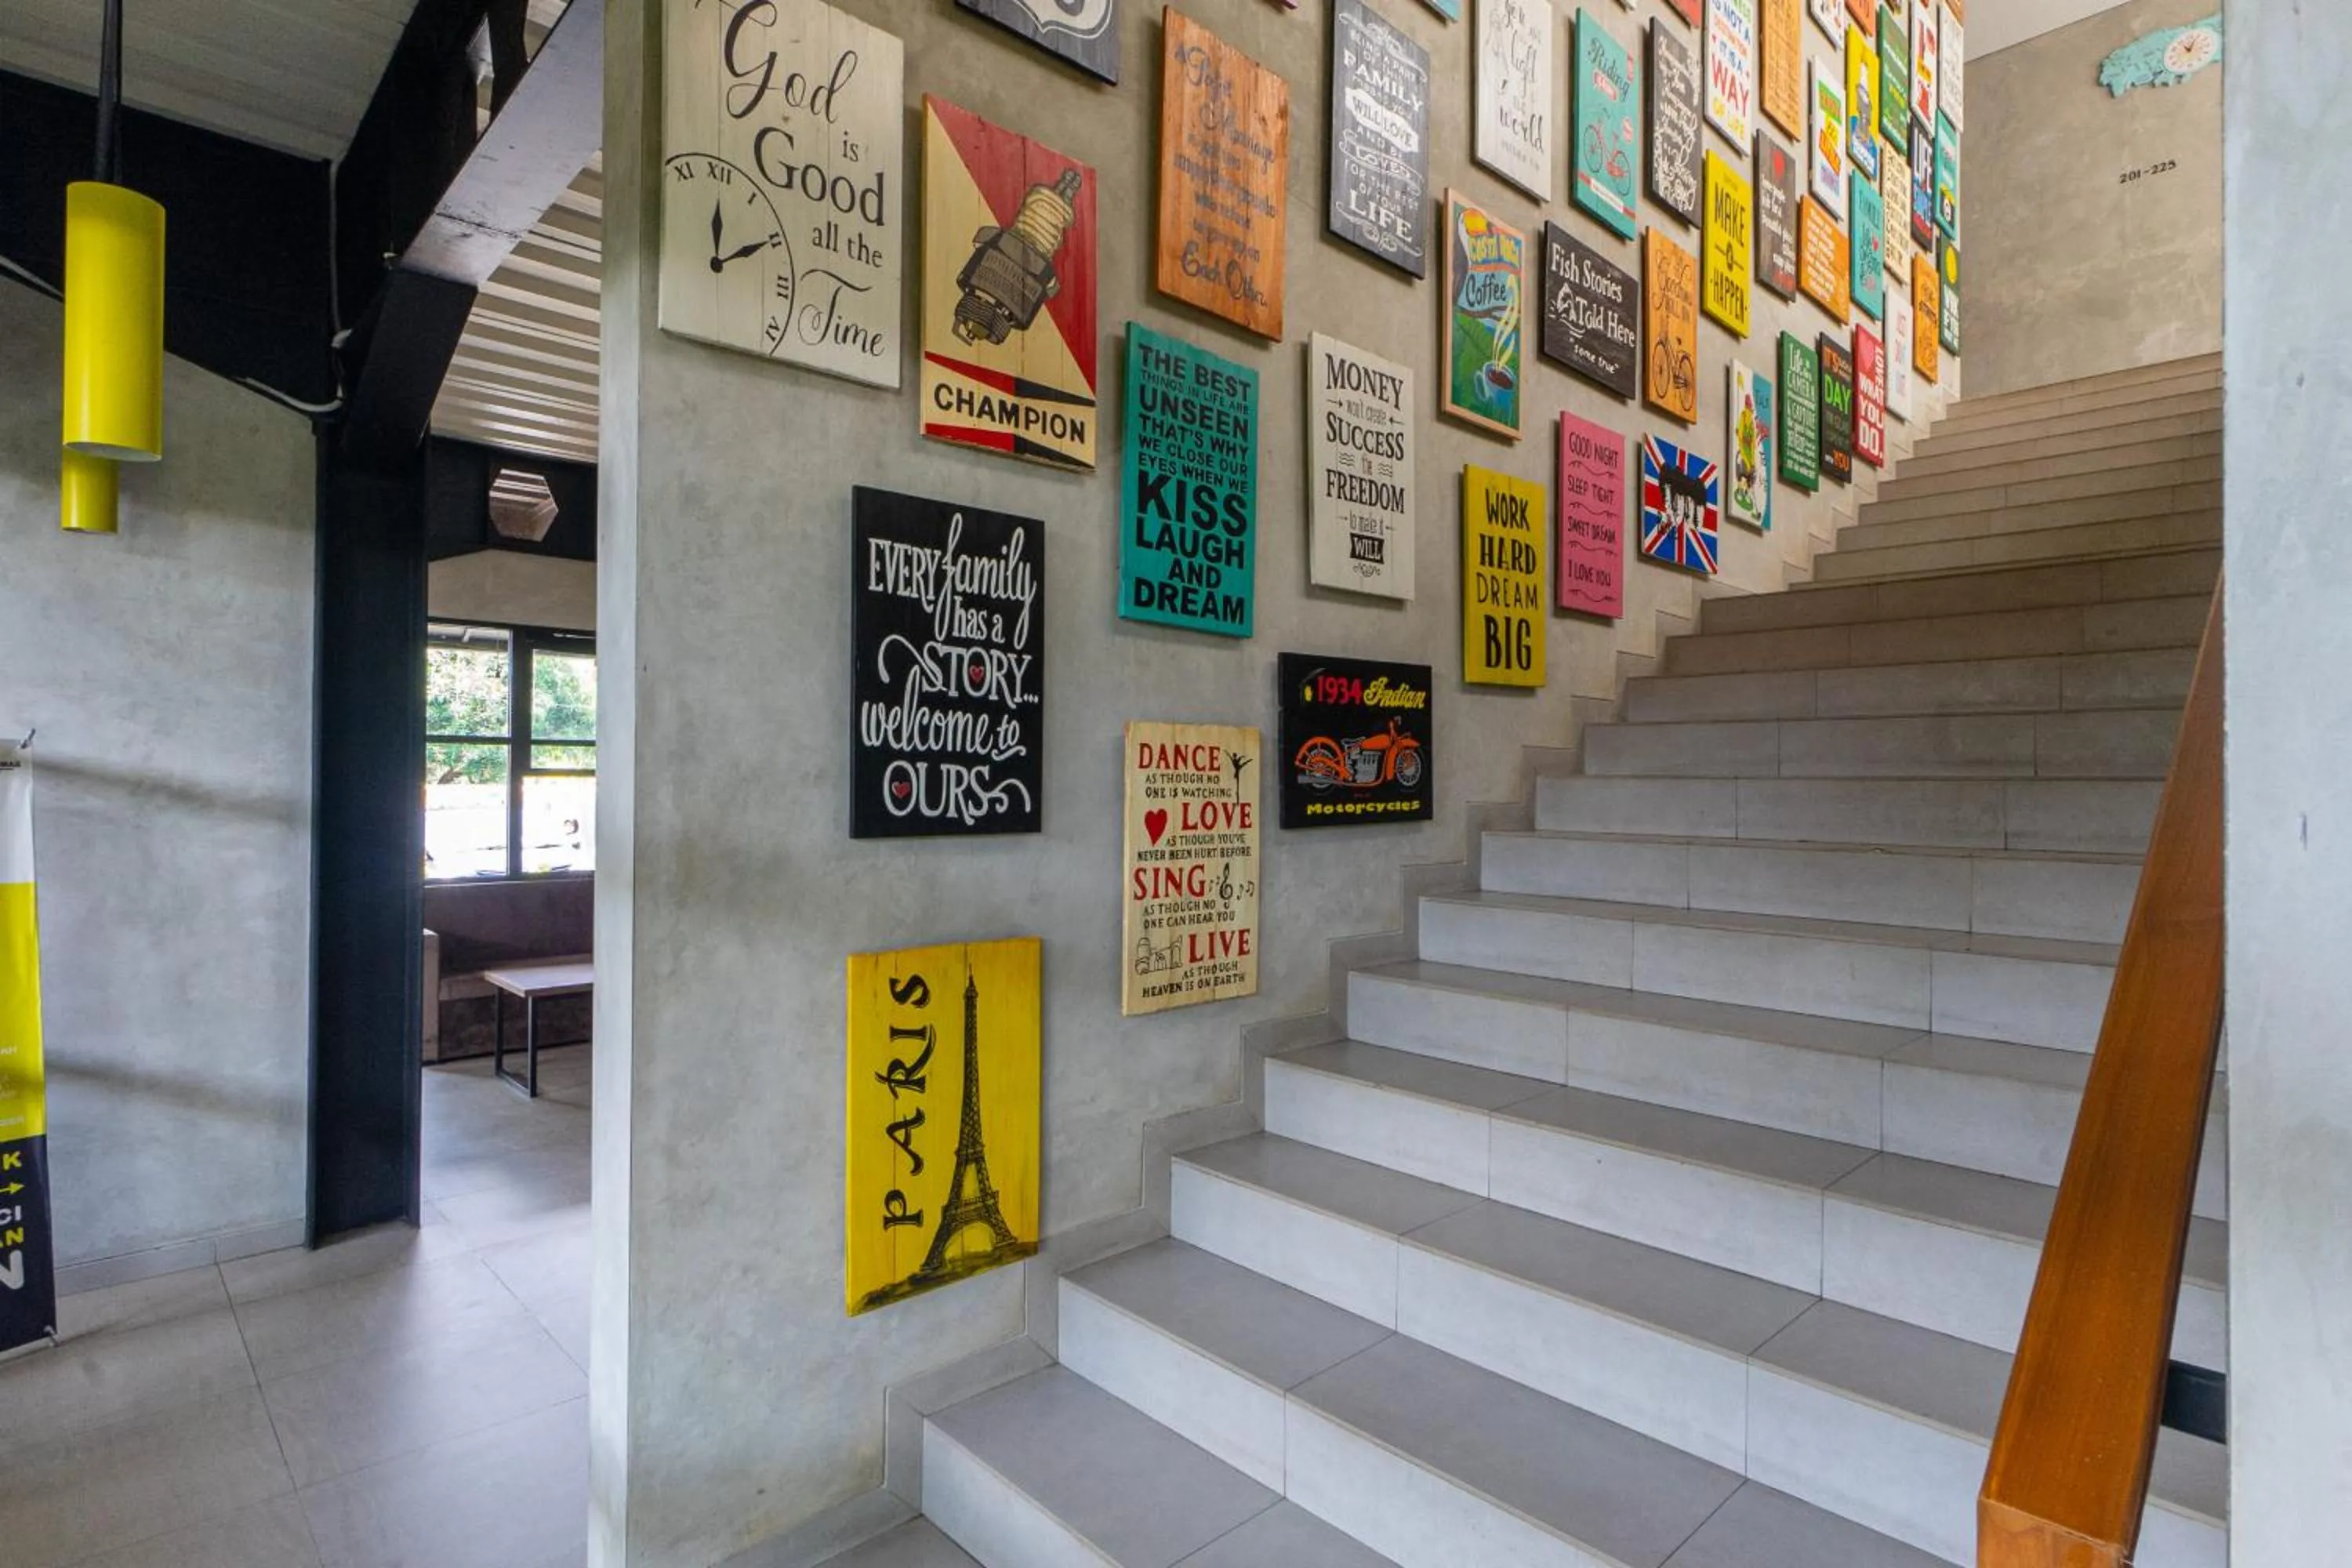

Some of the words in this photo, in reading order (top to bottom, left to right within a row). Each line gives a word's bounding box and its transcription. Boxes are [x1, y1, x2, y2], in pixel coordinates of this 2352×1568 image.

[706, 0, 858, 124] God
[1343, 48, 1423, 114] FAMILY
[1587, 38, 1630, 102] Riding
[1712, 54, 1748, 118] WAY
[1353, 96, 1378, 126] WILL
[1382, 114, 1412, 147] LOVE
[842, 131, 858, 162] is
[675, 162, 694, 180] XI
[706, 162, 731, 184] XII
[753, 126, 884, 226] Good
[1350, 188, 1412, 243] LIFE
[1715, 182, 1745, 248] MAKE
[812, 221, 838, 252] all
[848, 238, 882, 267] the
[778, 275, 789, 300] III
[1465, 274, 1506, 308] Coffee
[1551, 243, 1580, 283] Fish
[1584, 260, 1622, 302] Stories
[798, 269, 885, 356] Time
[1576, 297, 1603, 330] Told
[1608, 311, 1635, 347] Here
[1138, 344, 1186, 380] THE
[1195, 364, 1250, 402] BEST
[1142, 370, 1183, 392] THINGS
[1189, 386, 1199, 400] IN
[1203, 390, 1225, 408] LIFE
[1229, 401, 1248, 415] ARE
[1326, 353, 1403, 410] MONEY
[1824, 373, 1851, 414] DAY
[935, 383, 1085, 444] CHAMPION
[1139, 384, 1248, 443] UNSEEN
[1858, 393, 1883, 430] YOU
[1138, 434, 1160, 452] WE
[1167, 443, 1214, 468] CLOSE
[1219, 457, 1247, 477] OUR
[1139, 415, 1203, 448] THAT'S
[1210, 437, 1248, 462] WHY
[1326, 411, 1404, 461] SUCCESS
[1569, 432, 1593, 459] GOOD
[1595, 445, 1618, 469] NIGHT
[1859, 417, 1882, 459] DO.
[1138, 452, 1176, 476] EYES
[1182, 463, 1224, 487] WHEN
[1229, 478, 1247, 493] WE
[1326, 469, 1404, 514] FREEDOM
[1568, 474, 1588, 496] SLEEP
[1592, 485, 1614, 505] TIGHT
[1138, 471, 1247, 539] KISS
[1486, 488, 1530, 532] WORK
[1568, 516, 1589, 535] SWEET
[1136, 517, 1244, 569] LAUGH
[1354, 538, 1383, 560] WILL
[1479, 533, 1537, 575] HARD
[869, 537, 941, 613] EVERY
[935, 513, 1036, 649] family
[1168, 558, 1221, 589] AND
[1476, 572, 1537, 609] DREAM
[1569, 560, 1573, 578] I
[1575, 563, 1593, 583] LOVE
[1595, 568, 1611, 586] YOU
[954, 596, 986, 641] has
[993, 615, 1004, 644] a
[1134, 576, 1244, 625] DREAM
[1484, 614, 1532, 671] BIG
[862, 665, 993, 753] welcome
[991, 715, 1025, 760] to
[1317, 676, 1362, 705] 1934
[1363, 677, 1426, 709] Indian
[1138, 742, 1221, 771] DANCE
[884, 760, 1030, 825] OURS
[1145, 775, 1157, 783] AS
[1160, 774, 1203, 784] THOUGH
[1207, 775, 1220, 784] NO
[1145, 788, 1166, 799] ONE
[1170, 788, 1178, 798] IS
[1182, 787, 1232, 798] WATCHING
[1181, 802, 1251, 831] LOVE
[1307, 800, 1420, 815] Motorcycles
[1138, 849, 1166, 862] NEVER
[1168, 848, 1192, 860] BEEN
[1195, 848, 1218, 859] HURT
[1220, 846, 1251, 858] BEFORE
[1167, 836, 1176, 846] AS
[1179, 835, 1214, 846] THOUGH
[1218, 833, 1246, 844] YOU'VE
[1133, 863, 1206, 901] SING
[1143, 906, 1156, 916] AS
[1158, 902, 1201, 914] THOUGH
[1203, 900, 1216, 910] NO
[1144, 918, 1164, 930] ONE
[1167, 916, 1186, 927] CAN
[1189, 913, 1214, 924] HEAR
[1217, 911, 1235, 922] YOU
[1189, 928, 1250, 963] LIVE
[1142, 979, 1182, 997] HEAVEN
[1185, 978, 1194, 991] IS
[1198, 977, 1211, 988] ON
[1214, 973, 1245, 987] EARTH
[1181, 969, 1195, 980] AS
[1198, 961, 1238, 975] THOUGH
[876, 973, 935, 1229] PARIS
